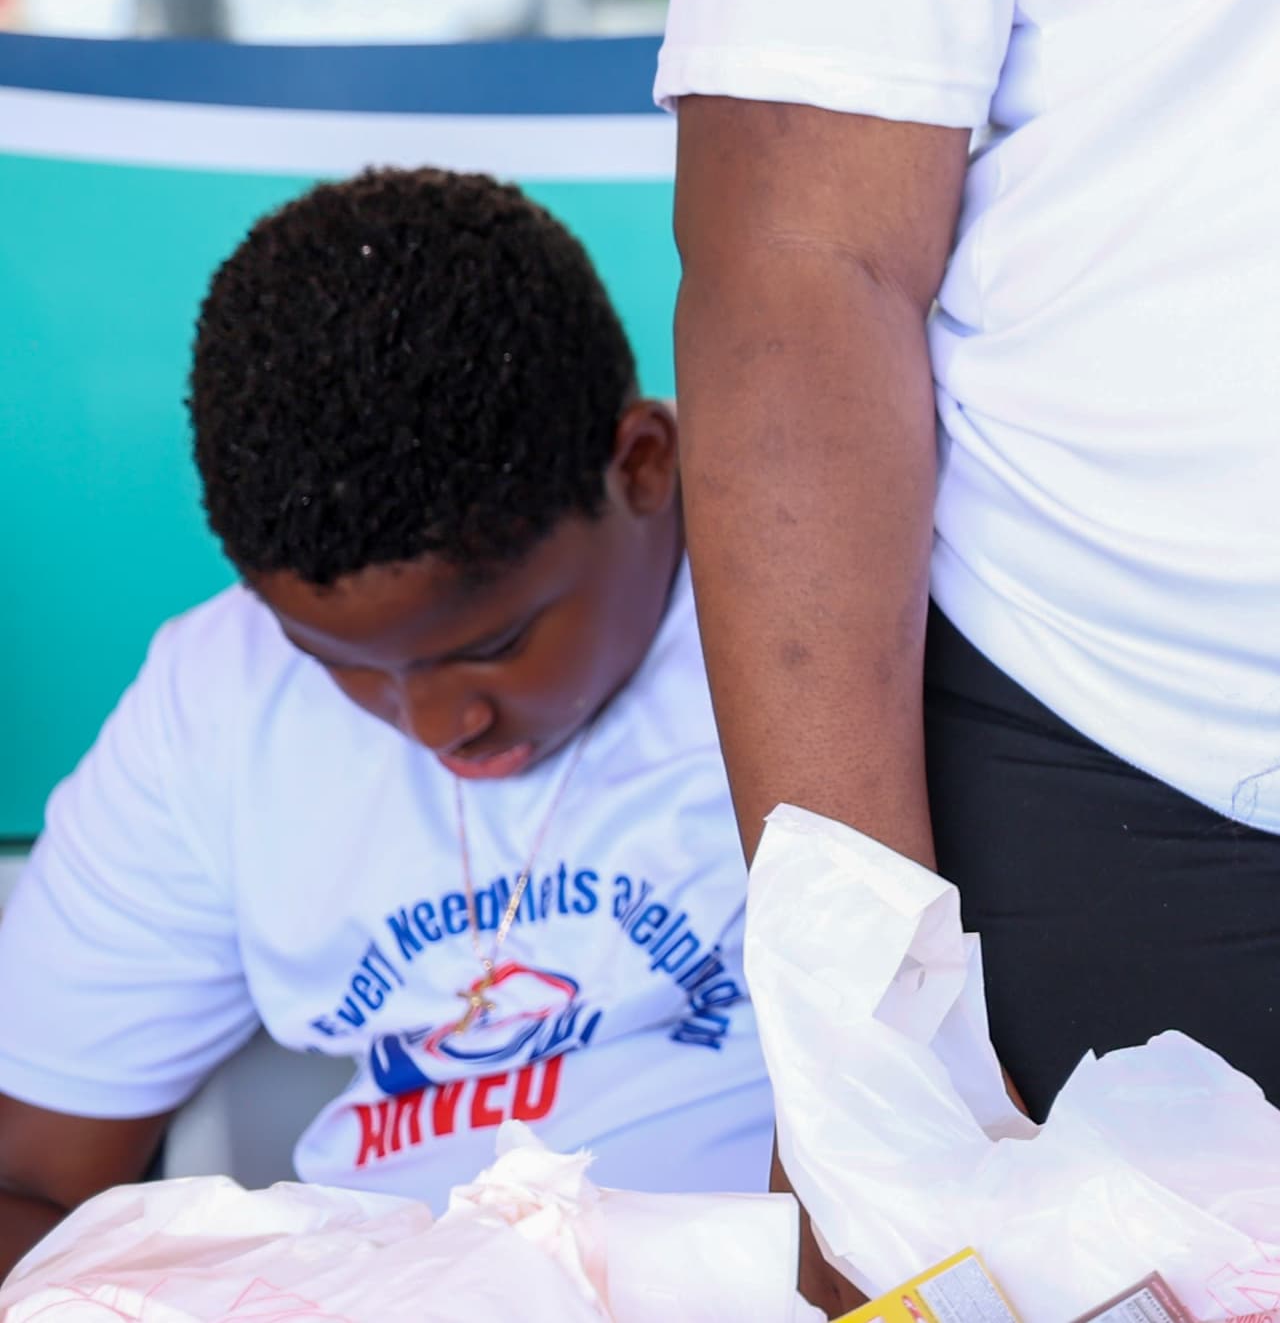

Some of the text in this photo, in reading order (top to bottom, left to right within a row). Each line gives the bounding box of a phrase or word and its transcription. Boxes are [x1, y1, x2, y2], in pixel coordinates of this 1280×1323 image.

[386, 876, 509, 962] Need
[510, 859, 598, 926] Mts
[617, 879, 742, 1018] elping
